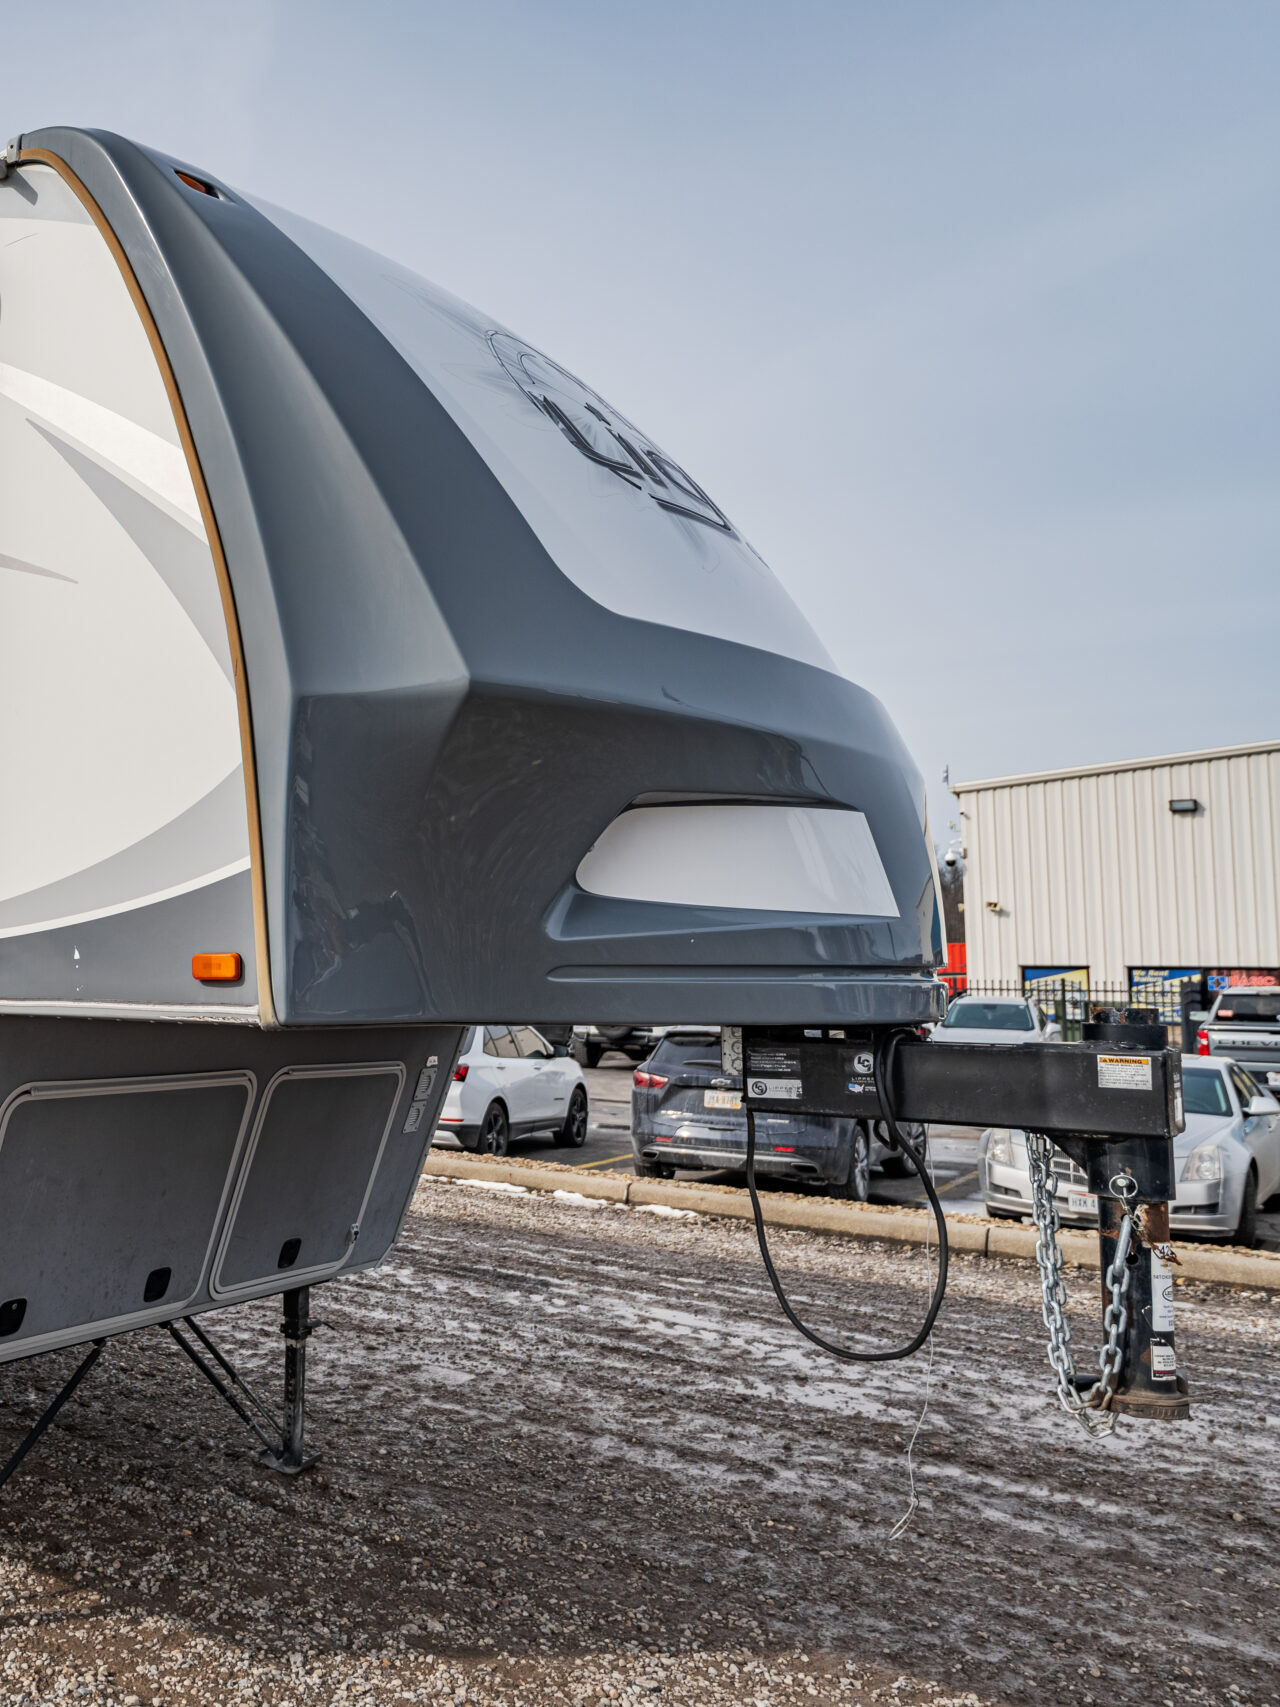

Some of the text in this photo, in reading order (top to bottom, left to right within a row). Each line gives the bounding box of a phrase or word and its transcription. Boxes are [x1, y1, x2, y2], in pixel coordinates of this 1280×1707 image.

[1132, 969, 1169, 977] We Rent
[1109, 1057, 1143, 1065] WARNING
